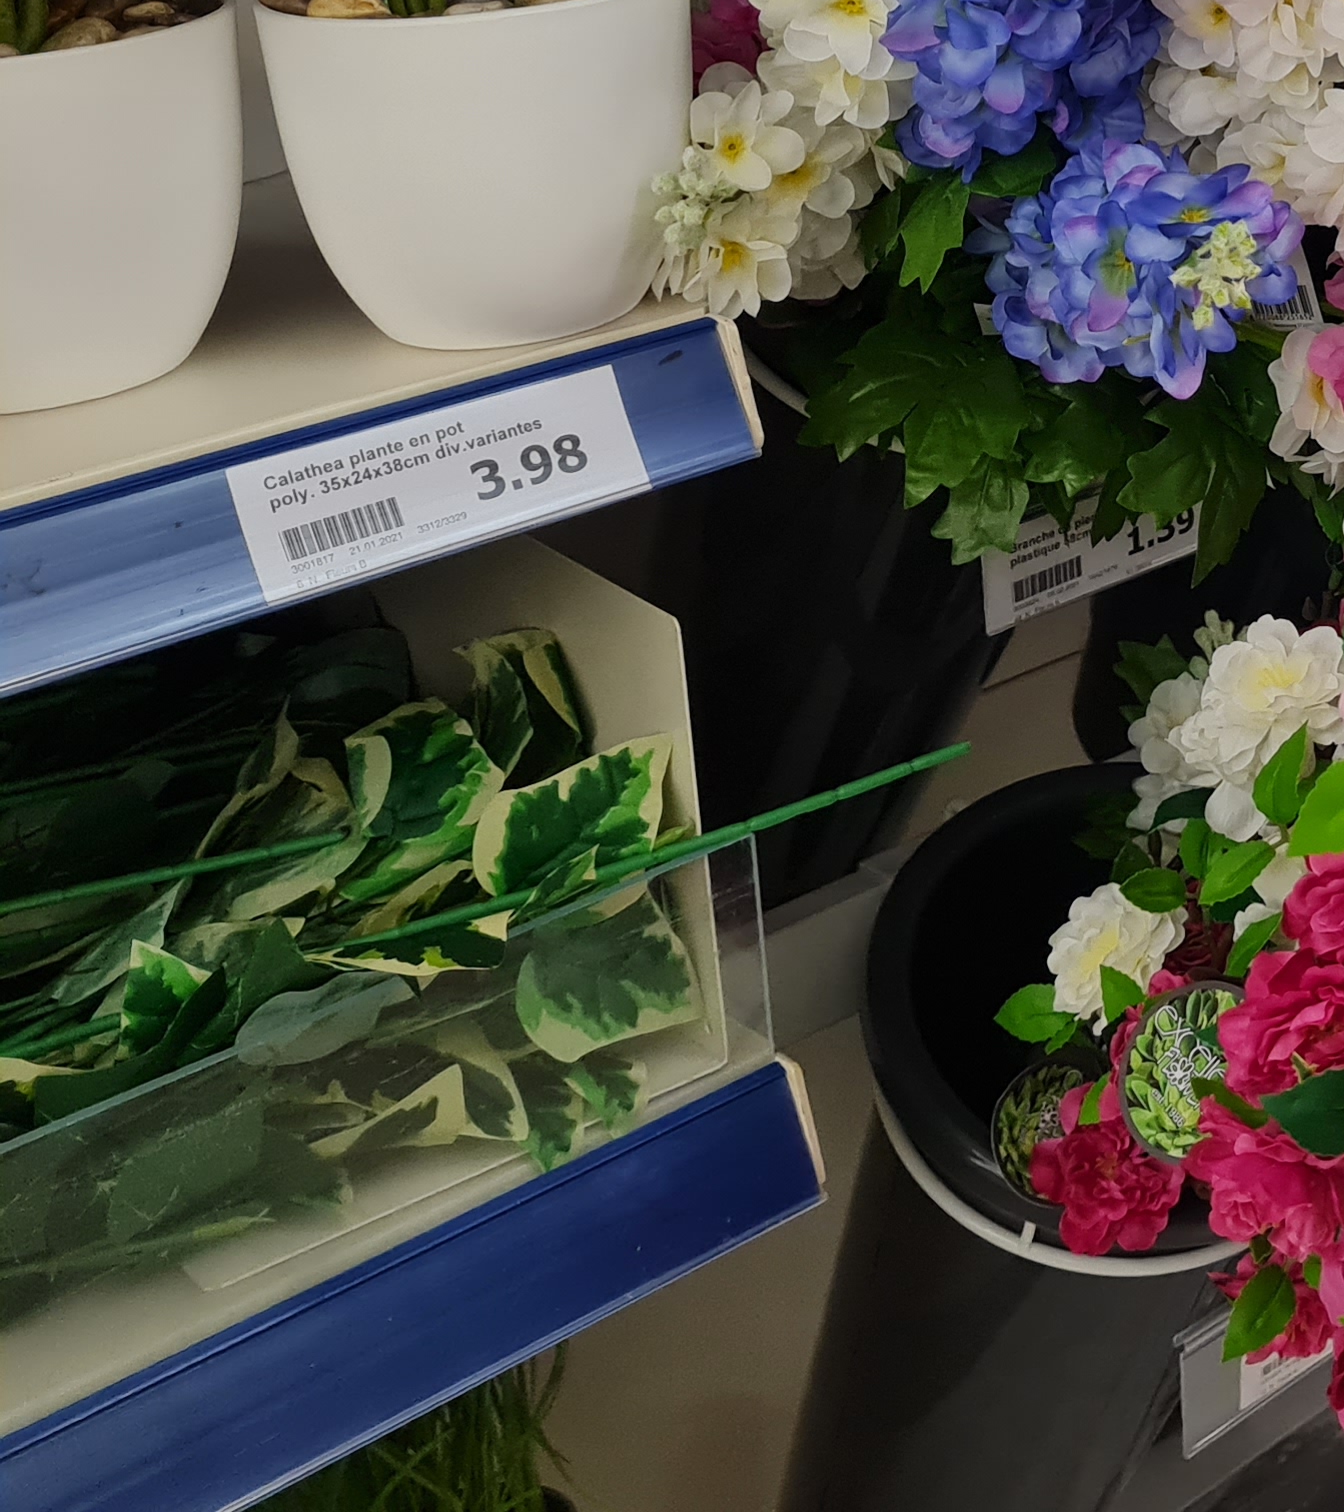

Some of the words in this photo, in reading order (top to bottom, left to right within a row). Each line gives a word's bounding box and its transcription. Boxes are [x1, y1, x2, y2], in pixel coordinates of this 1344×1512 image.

[263, 459, 345, 491] Calathea
[349, 440, 404, 469] plante
[408, 433, 431, 448] en
[435, 421, 465, 444] pot
[269, 488, 316, 513] poly.
[319, 452, 430, 495] 35x24x38cm
[435, 419, 543, 460] div.variantes
[469, 433, 588, 501] 3.98
[290, 553, 335, 575] 3001817
[348, 531, 404, 556] 21.01.2021
[416, 511, 467, 534] 3312/3329
[1010, 539, 1061, 570] plastique
[1165, 1104, 1186, 1129] 1986
